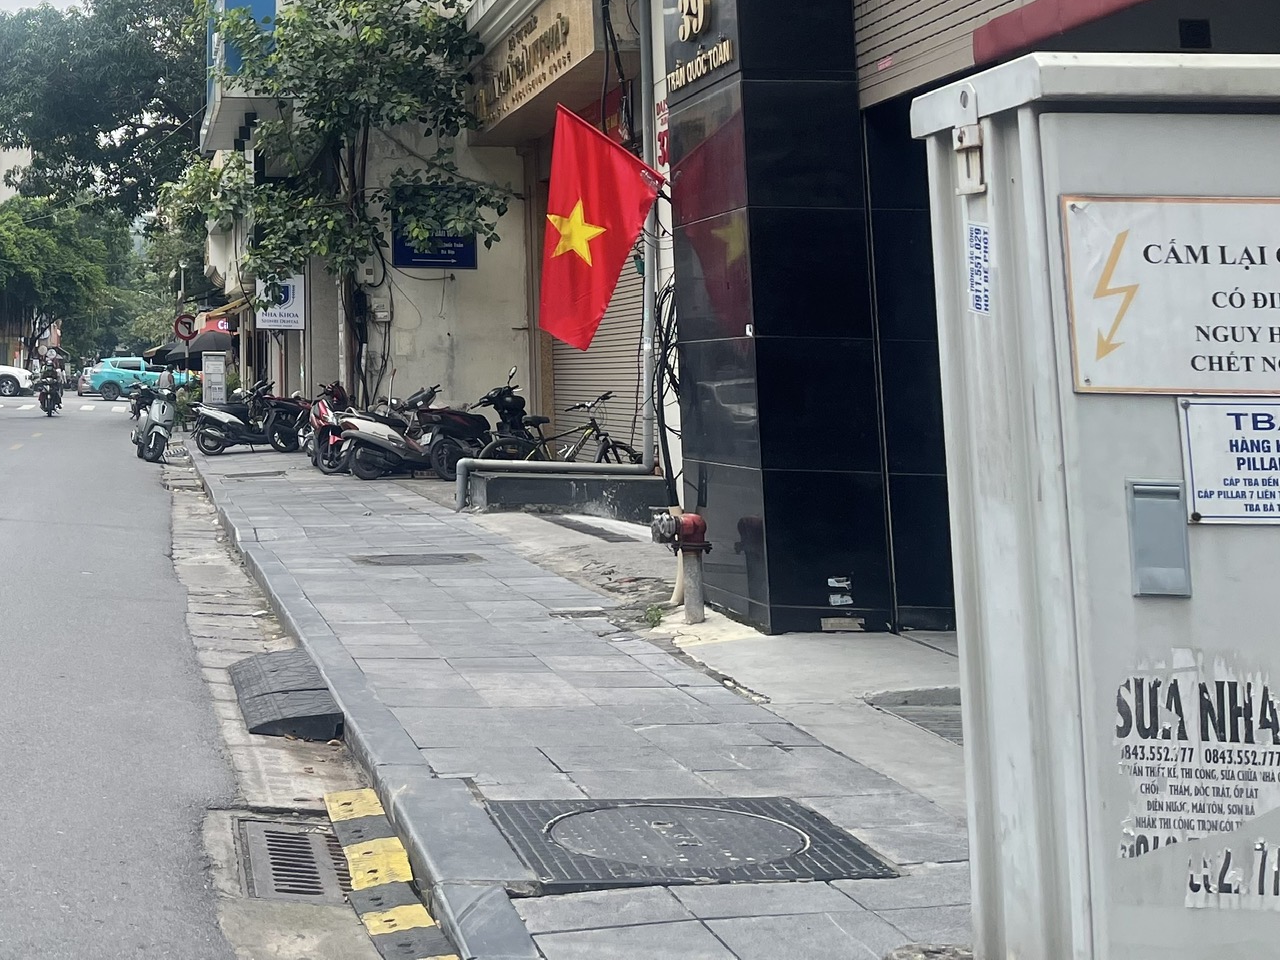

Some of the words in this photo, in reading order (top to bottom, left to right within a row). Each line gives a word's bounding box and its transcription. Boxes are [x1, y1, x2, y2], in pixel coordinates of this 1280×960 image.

[1143, 238, 1211, 265] CẤM
[1218, 245, 1268, 271] LẠI
[974, 228, 982, 310] 0911.551.029
[1212, 286, 1246, 309] CÓ
[1195, 325, 1262, 343] NGUY
[1190, 351, 1255, 372] CHẾT
[1226, 412, 1280, 431] TB
[1229, 436, 1271, 453] HÀNG
[1243, 478, 1259, 487] TBA
[1217, 490, 1246, 499] PILLAR
[1249, 490, 1254, 499] 7
[1244, 503, 1261, 512] TBA
[1181, 768, 1193, 779] THI
[1159, 817, 1171, 829] THI
